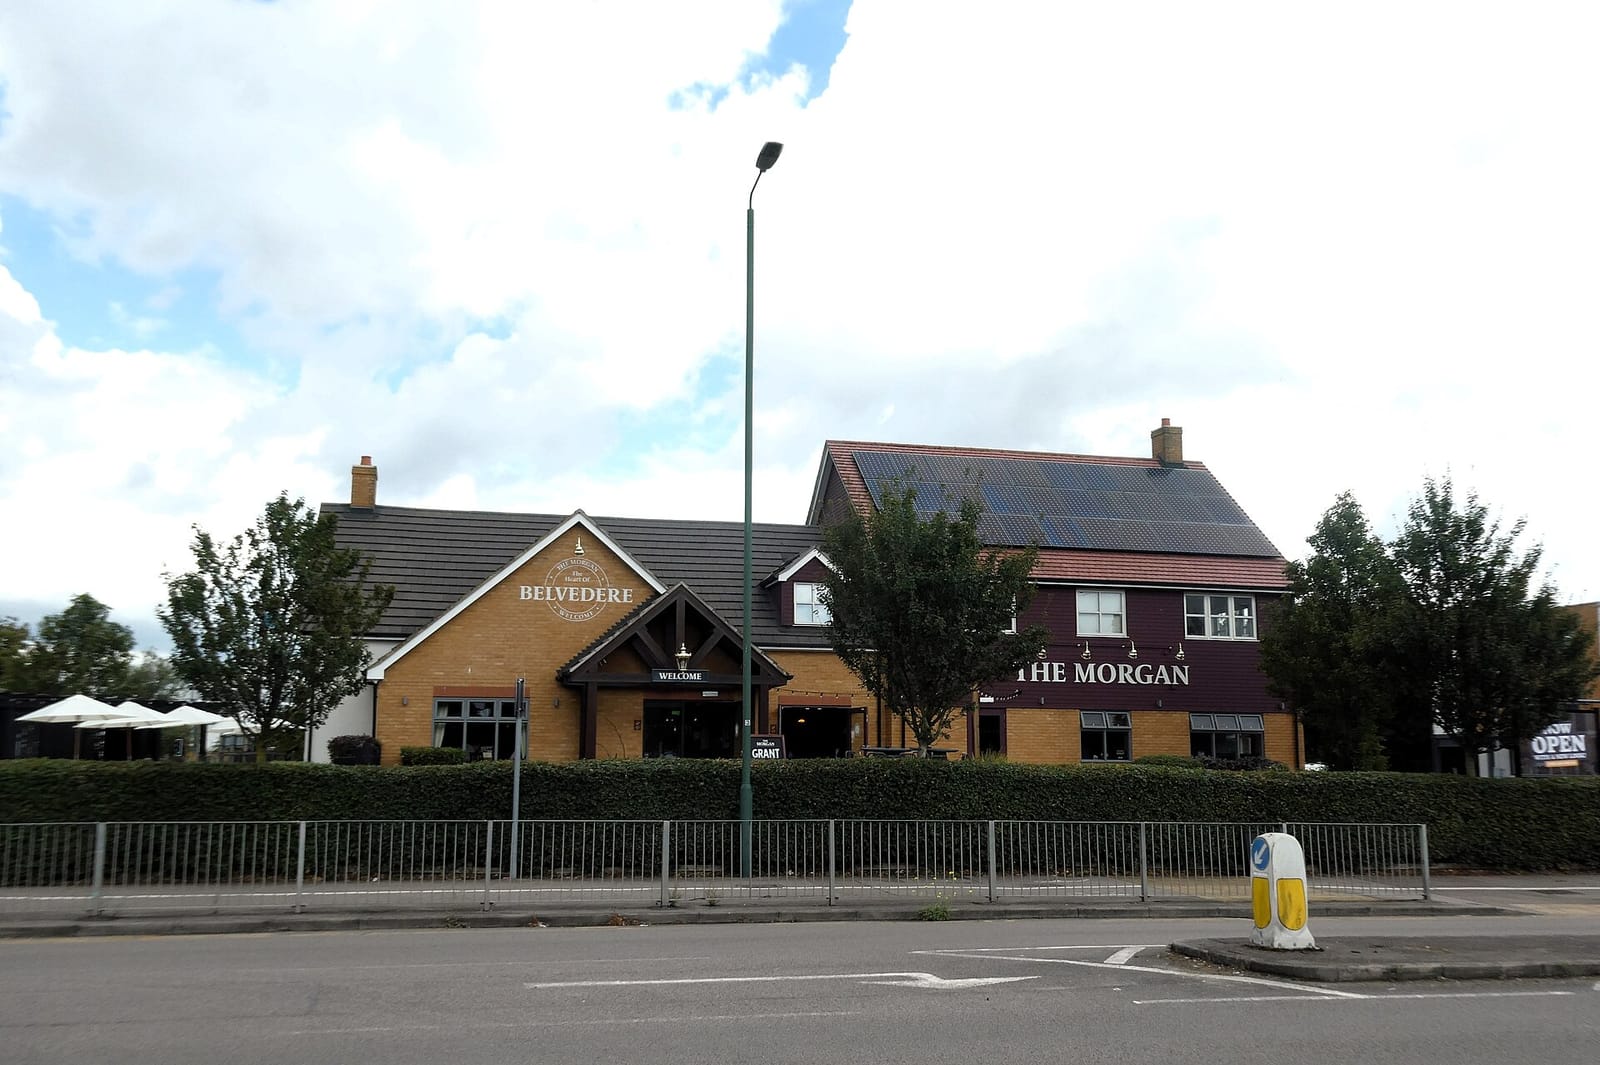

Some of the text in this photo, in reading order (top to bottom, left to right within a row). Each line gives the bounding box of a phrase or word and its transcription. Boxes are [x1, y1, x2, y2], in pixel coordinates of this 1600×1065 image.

[519, 585, 633, 603] BELVEDERE
[559, 609, 594, 620] WELCOME
[659, 672, 702, 681] WELCOME
[1073, 662, 1190, 686] MORGAN
[1531, 734, 1586, 754] OPEN
[751, 748, 780, 759] GRANT
